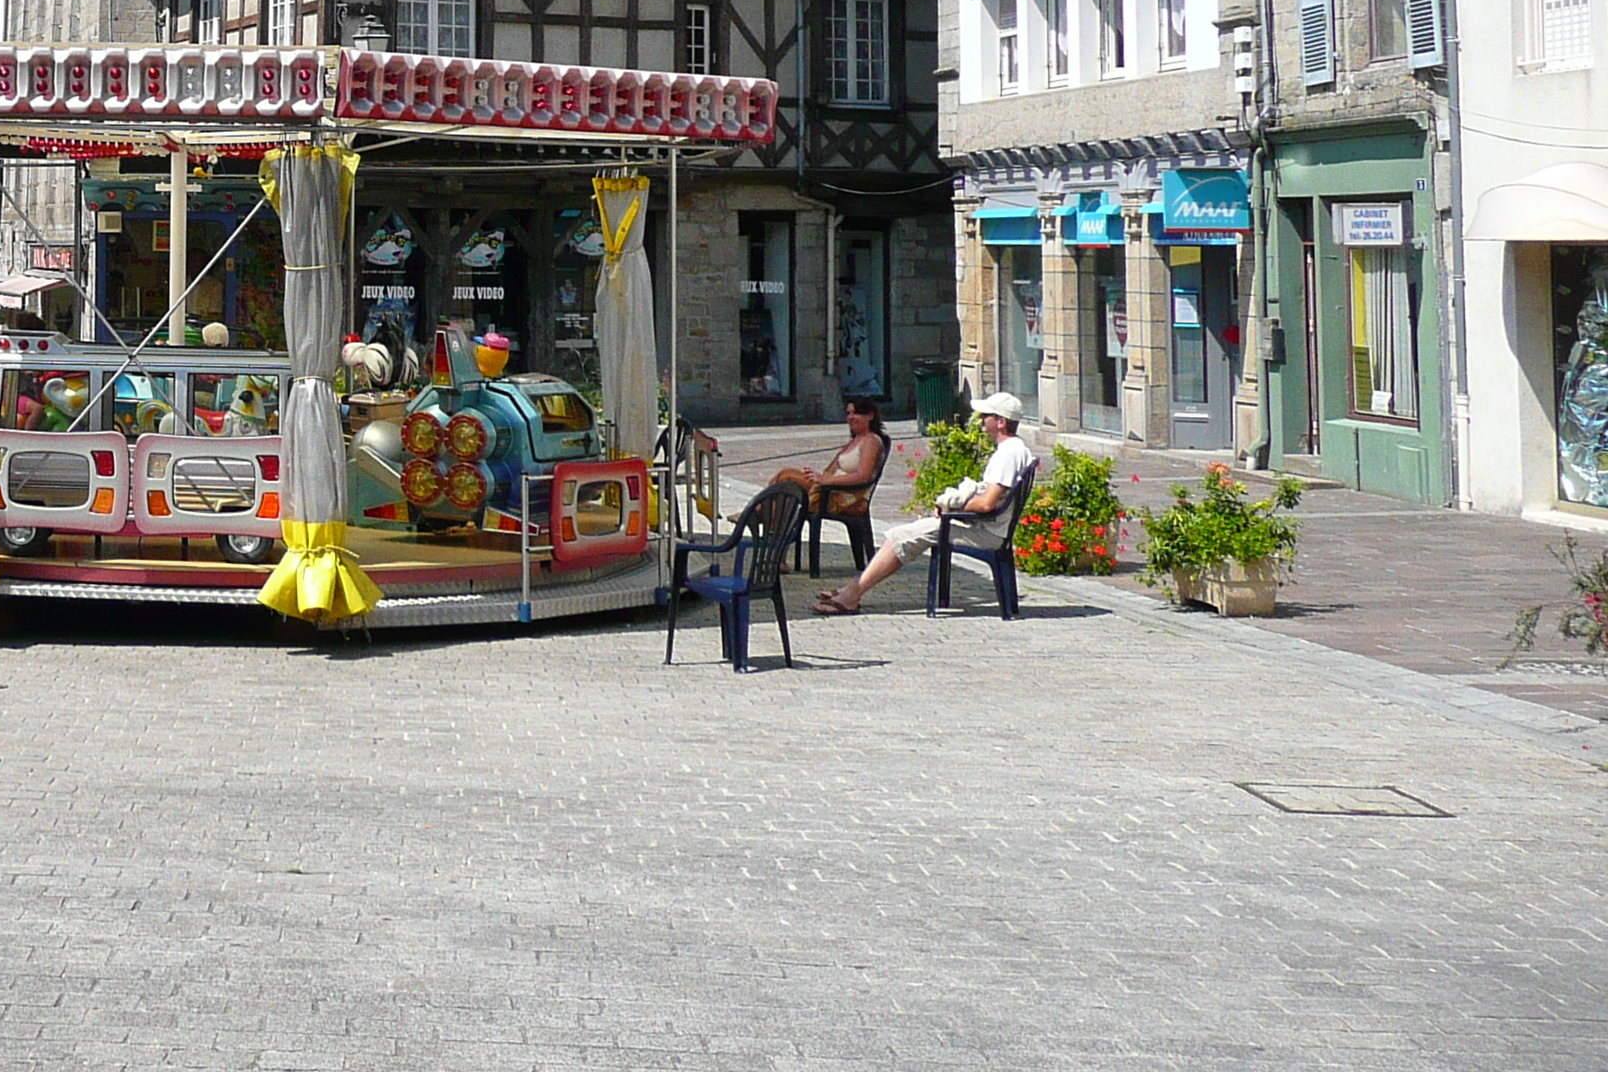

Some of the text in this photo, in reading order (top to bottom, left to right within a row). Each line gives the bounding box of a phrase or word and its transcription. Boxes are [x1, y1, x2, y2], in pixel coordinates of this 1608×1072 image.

[1173, 201, 1243, 218] MAAF
[1353, 209, 1388, 218] CABINET
[1081, 220, 1105, 234] MAAF
[1351, 220, 1392, 229] INFIRMIER
[362, 285, 415, 299] JEUX VIDEO
[453, 286, 504, 300] JEUX VIDEO
[740, 280, 784, 293] EUX VIDEO
